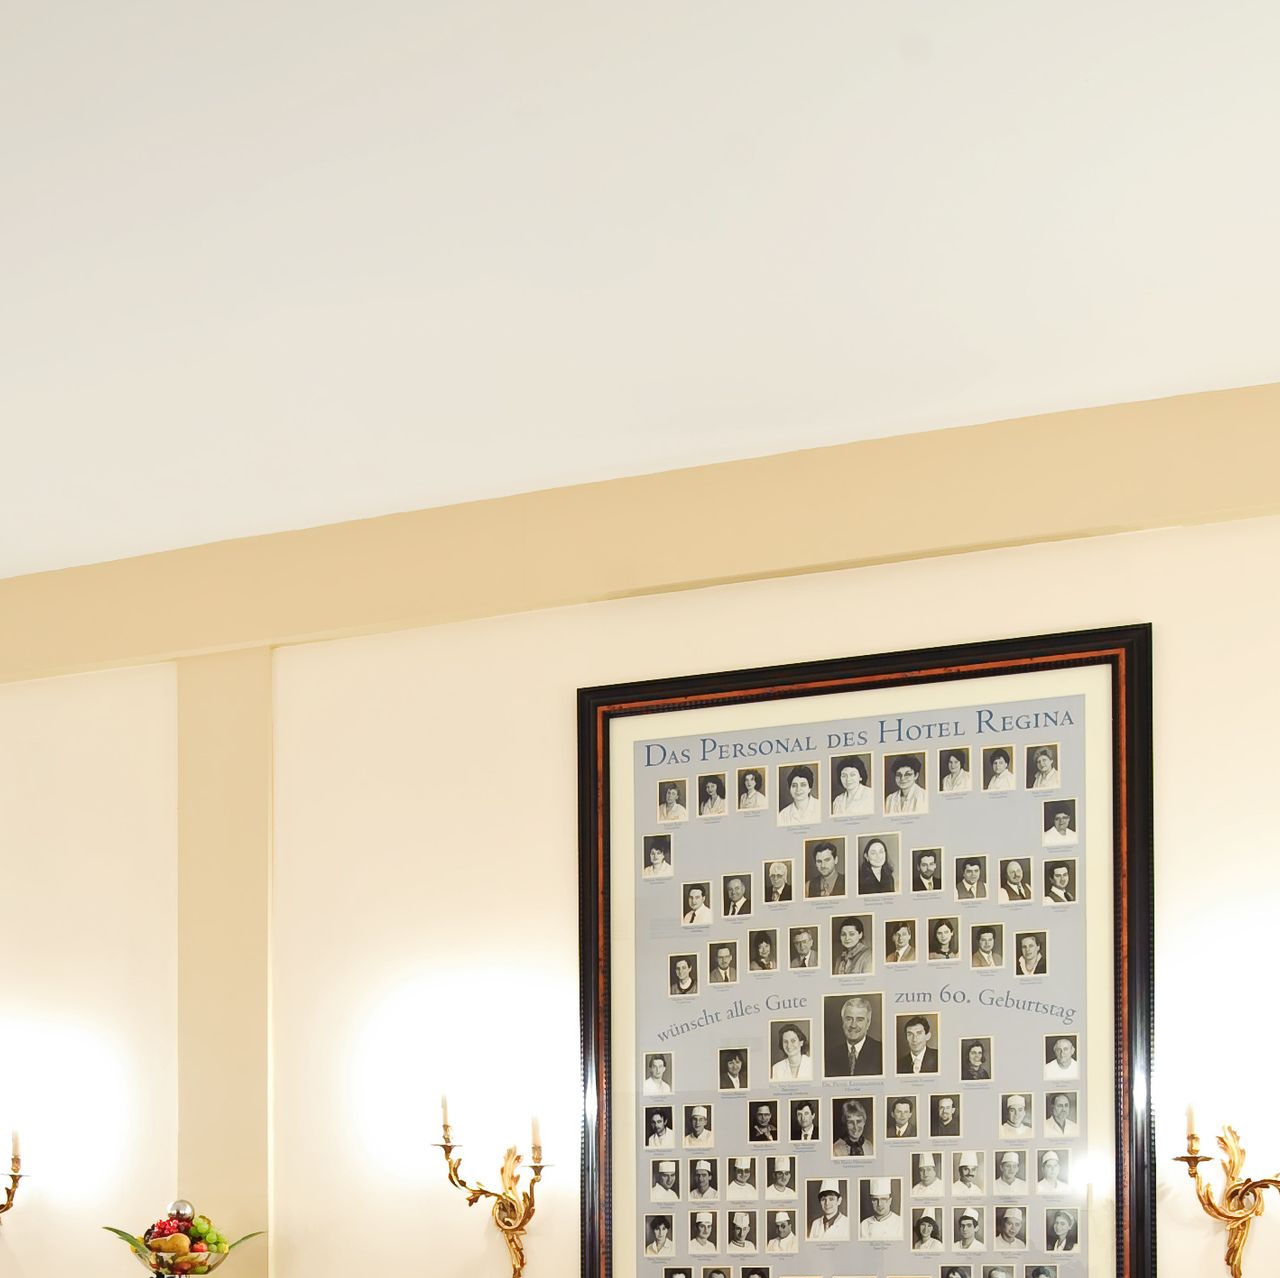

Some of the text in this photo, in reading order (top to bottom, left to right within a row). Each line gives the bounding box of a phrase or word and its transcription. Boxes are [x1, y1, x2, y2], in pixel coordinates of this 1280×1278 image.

[656, 992, 808, 1043] wünscht alles Gute
[894, 983, 1078, 1026] zum 60. Geburtstag
